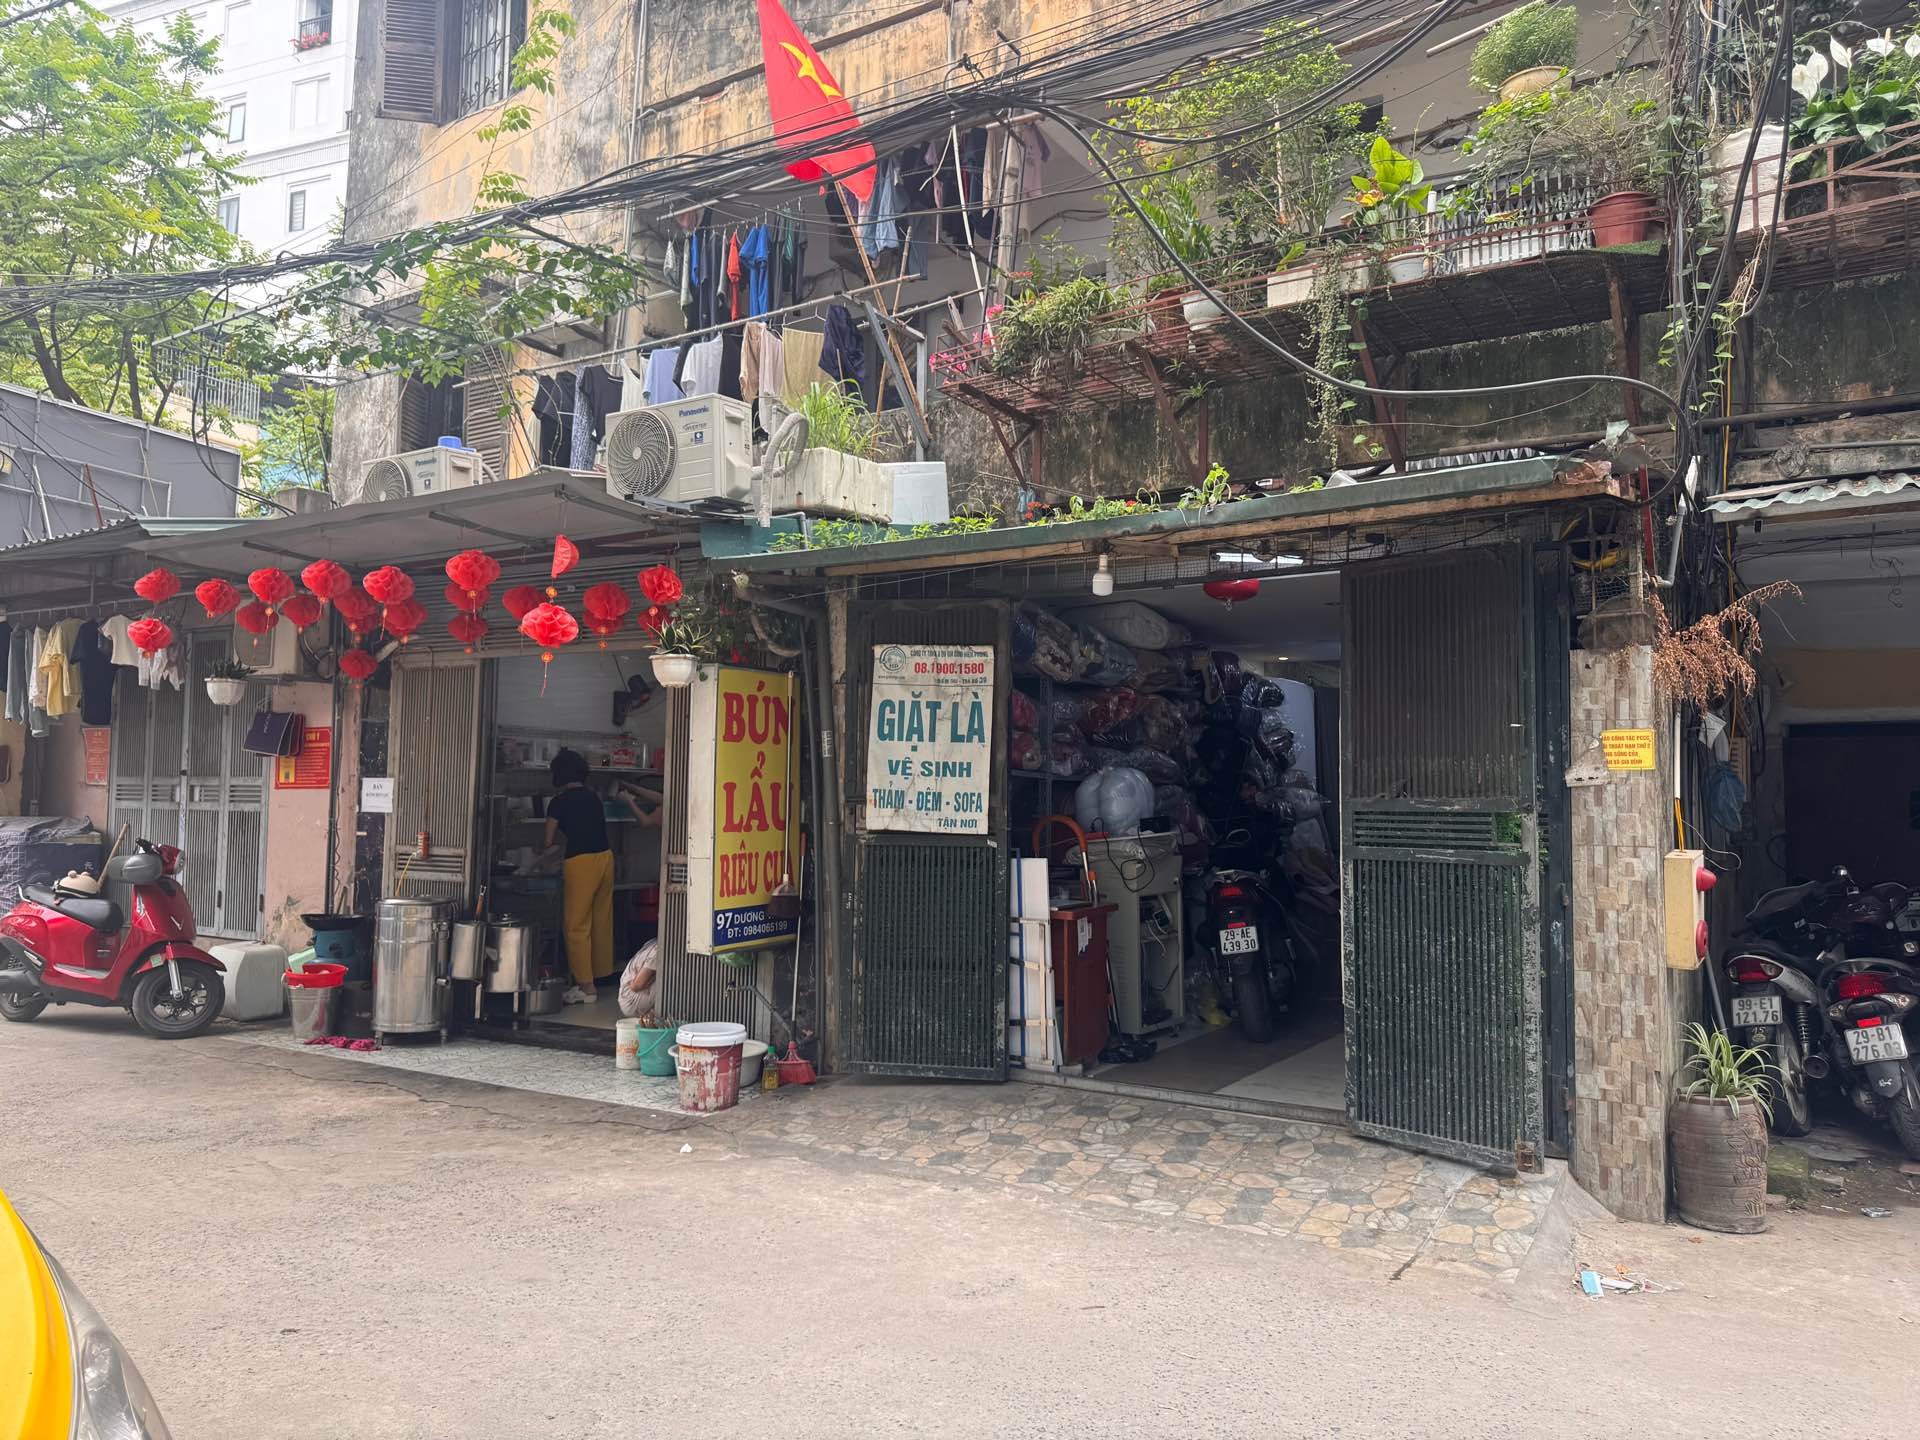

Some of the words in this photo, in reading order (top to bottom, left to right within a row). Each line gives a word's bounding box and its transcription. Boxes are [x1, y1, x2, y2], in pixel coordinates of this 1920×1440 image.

[679, 405, 710, 417] Panasonic
[914, 662, 985, 675] 08.1900.1580
[722, 680, 796, 745] BÚN
[877, 691, 942, 752] GIẶT
[950, 691, 985, 743] LÀ
[888, 757, 913, 780] VỆ
[920, 760, 972, 778] SINH
[722, 751, 793, 833] LẨU
[872, 781, 905, 810] THẢM
[916, 787, 942, 816] ĐỆM
[953, 792, 983, 813] SOFA
[938, 817, 957, 829] TẬN
[960, 817, 977, 828] NƠI
[719, 840, 760, 898] RIÊU
[716, 911, 733, 930] 97
[727, 927, 742, 939] ĐT:
[1224, 928, 1252, 941] 29-AE
[1223, 939, 1256, 952] 439.30
[1738, 998, 1773, 1011] 99-E1
[1736, 1010, 1779, 1025] 121.76
[1853, 1026, 1893, 1045] 29-B1
